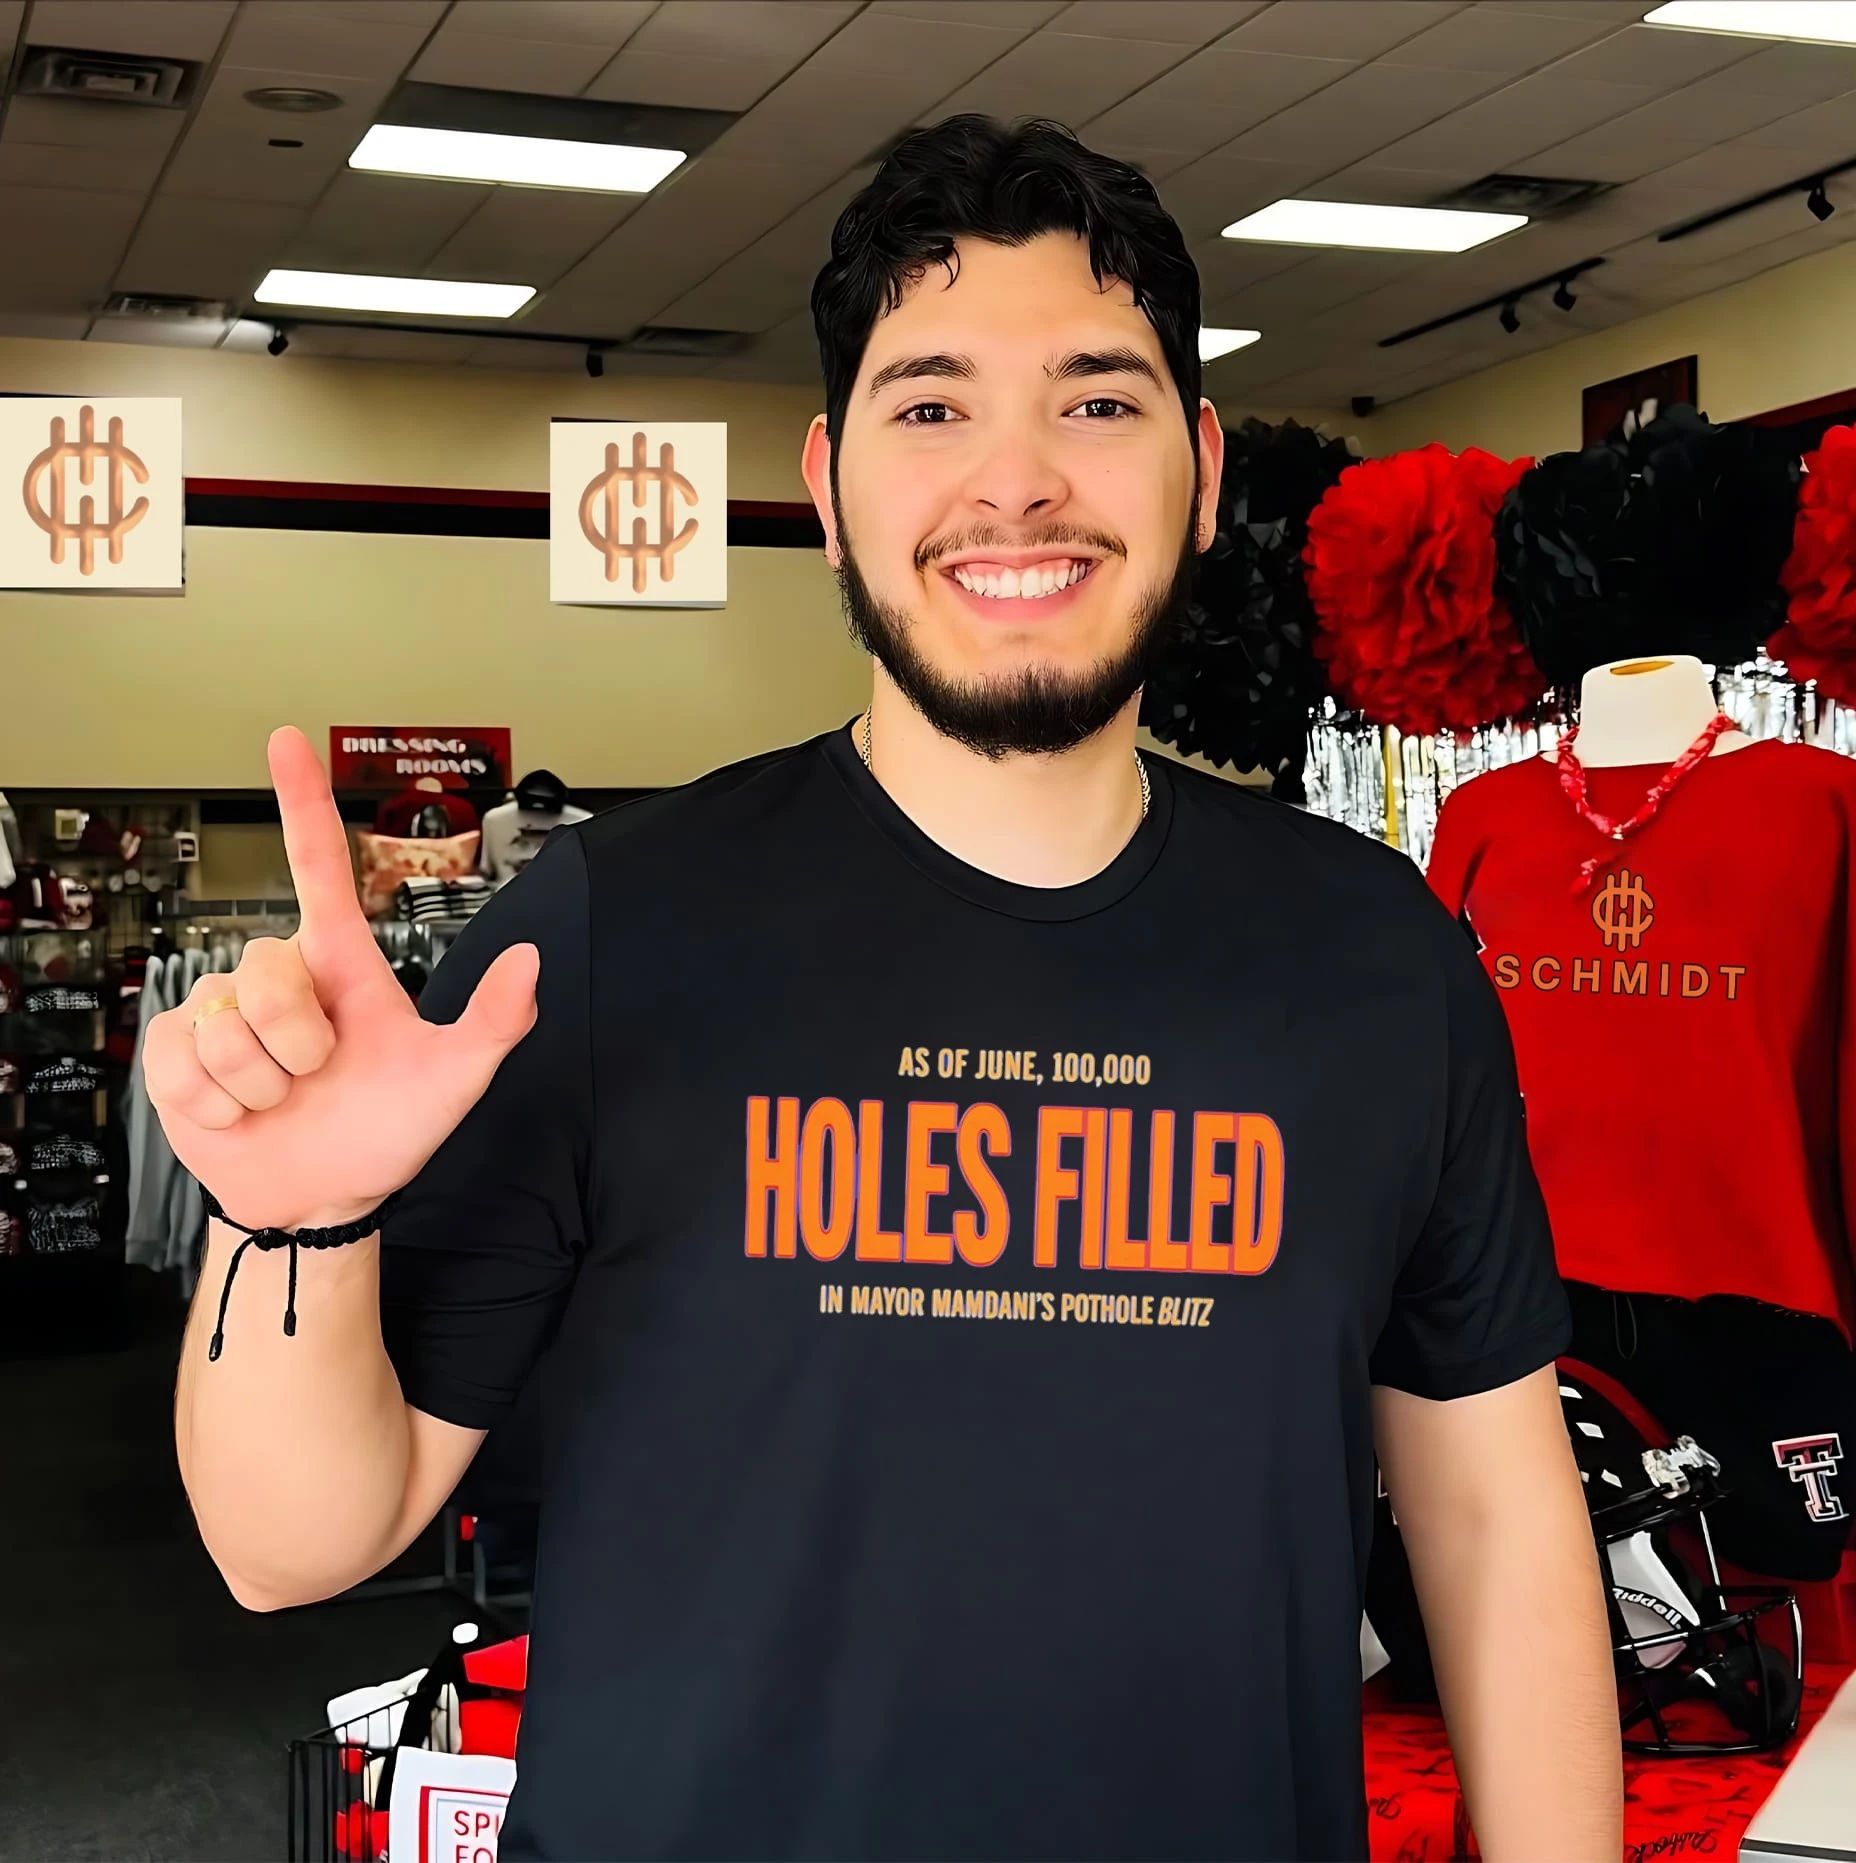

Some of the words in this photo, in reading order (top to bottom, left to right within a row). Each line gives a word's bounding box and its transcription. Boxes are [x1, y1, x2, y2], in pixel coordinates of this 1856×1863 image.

[342, 737, 467, 754] DRESSING
[396, 758, 487, 775] ROOMS
[1494, 954, 1746, 1000] SCHMIDT
[898, 1046, 930, 1078] AS
[938, 1047, 970, 1079] OF
[974, 1049, 1043, 1087] JUNE,
[1052, 1051, 1151, 1088] 100,000
[744, 1096, 1011, 1266] HOLES
[1033, 1106, 1285, 1275] FILLED
[820, 1284, 843, 1314] IN
[851, 1285, 925, 1317] MAYOR
[931, 1288, 1055, 1322] MAMDANI'S
[1061, 1293, 1154, 1325] POTHOLE
[1157, 1296, 1214, 1328] BLITZ
